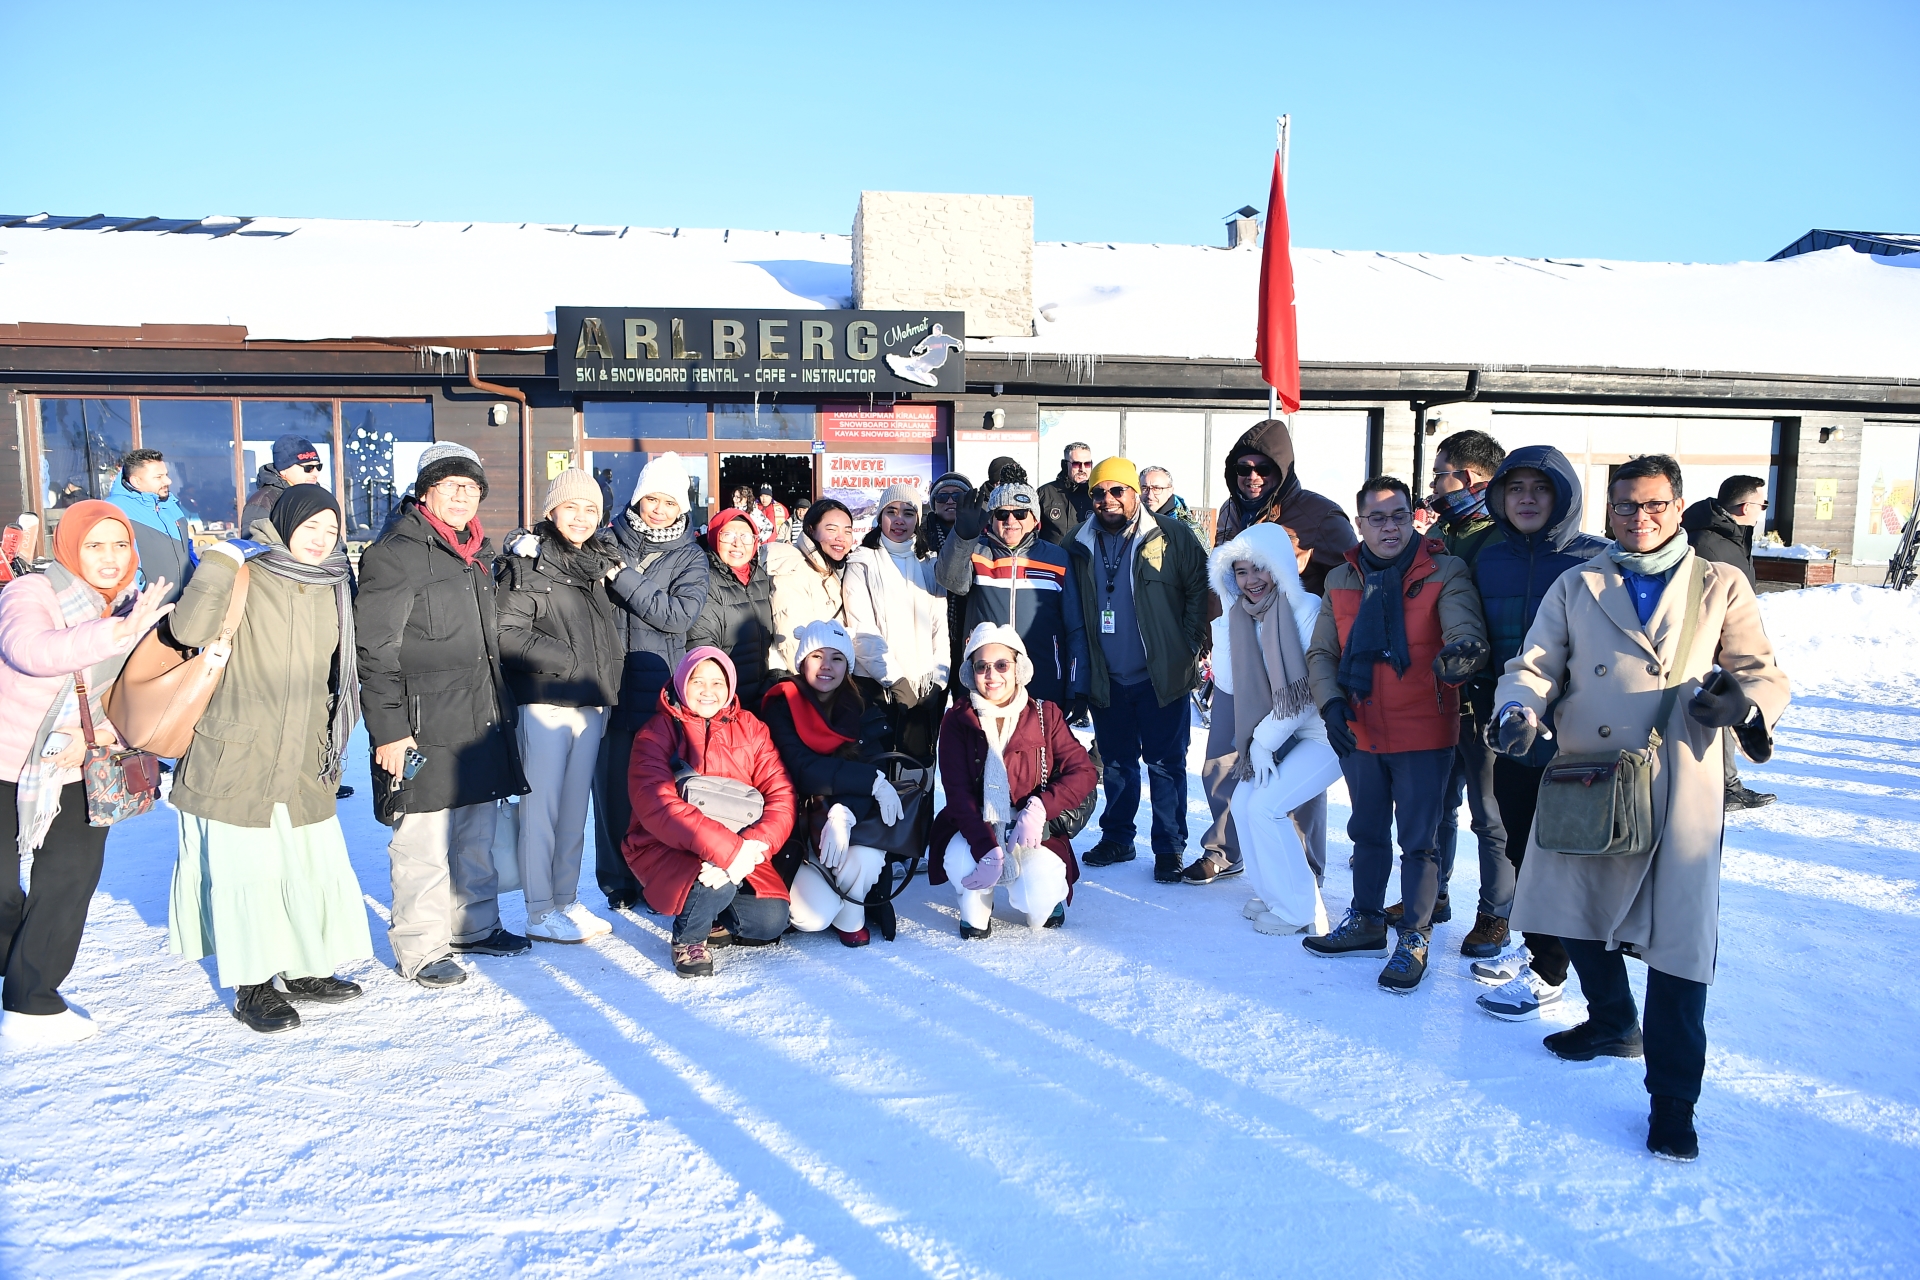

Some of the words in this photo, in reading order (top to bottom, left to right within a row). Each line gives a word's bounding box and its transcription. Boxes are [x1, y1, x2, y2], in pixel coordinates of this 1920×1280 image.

[575, 317, 878, 360] ARLBERG
[884, 317, 929, 347] Mehmet
[576, 368, 596, 382] SKI
[599, 369, 608, 381] &
[611, 367, 687, 382] SNOWBOARD
[692, 368, 739, 382] RENTAL
[755, 368, 786, 383] CAFE
[802, 368, 875, 383] INSTRUCTOR
[830, 457, 884, 471] ZİRVEYE
[831, 477, 870, 488] HAZIR
